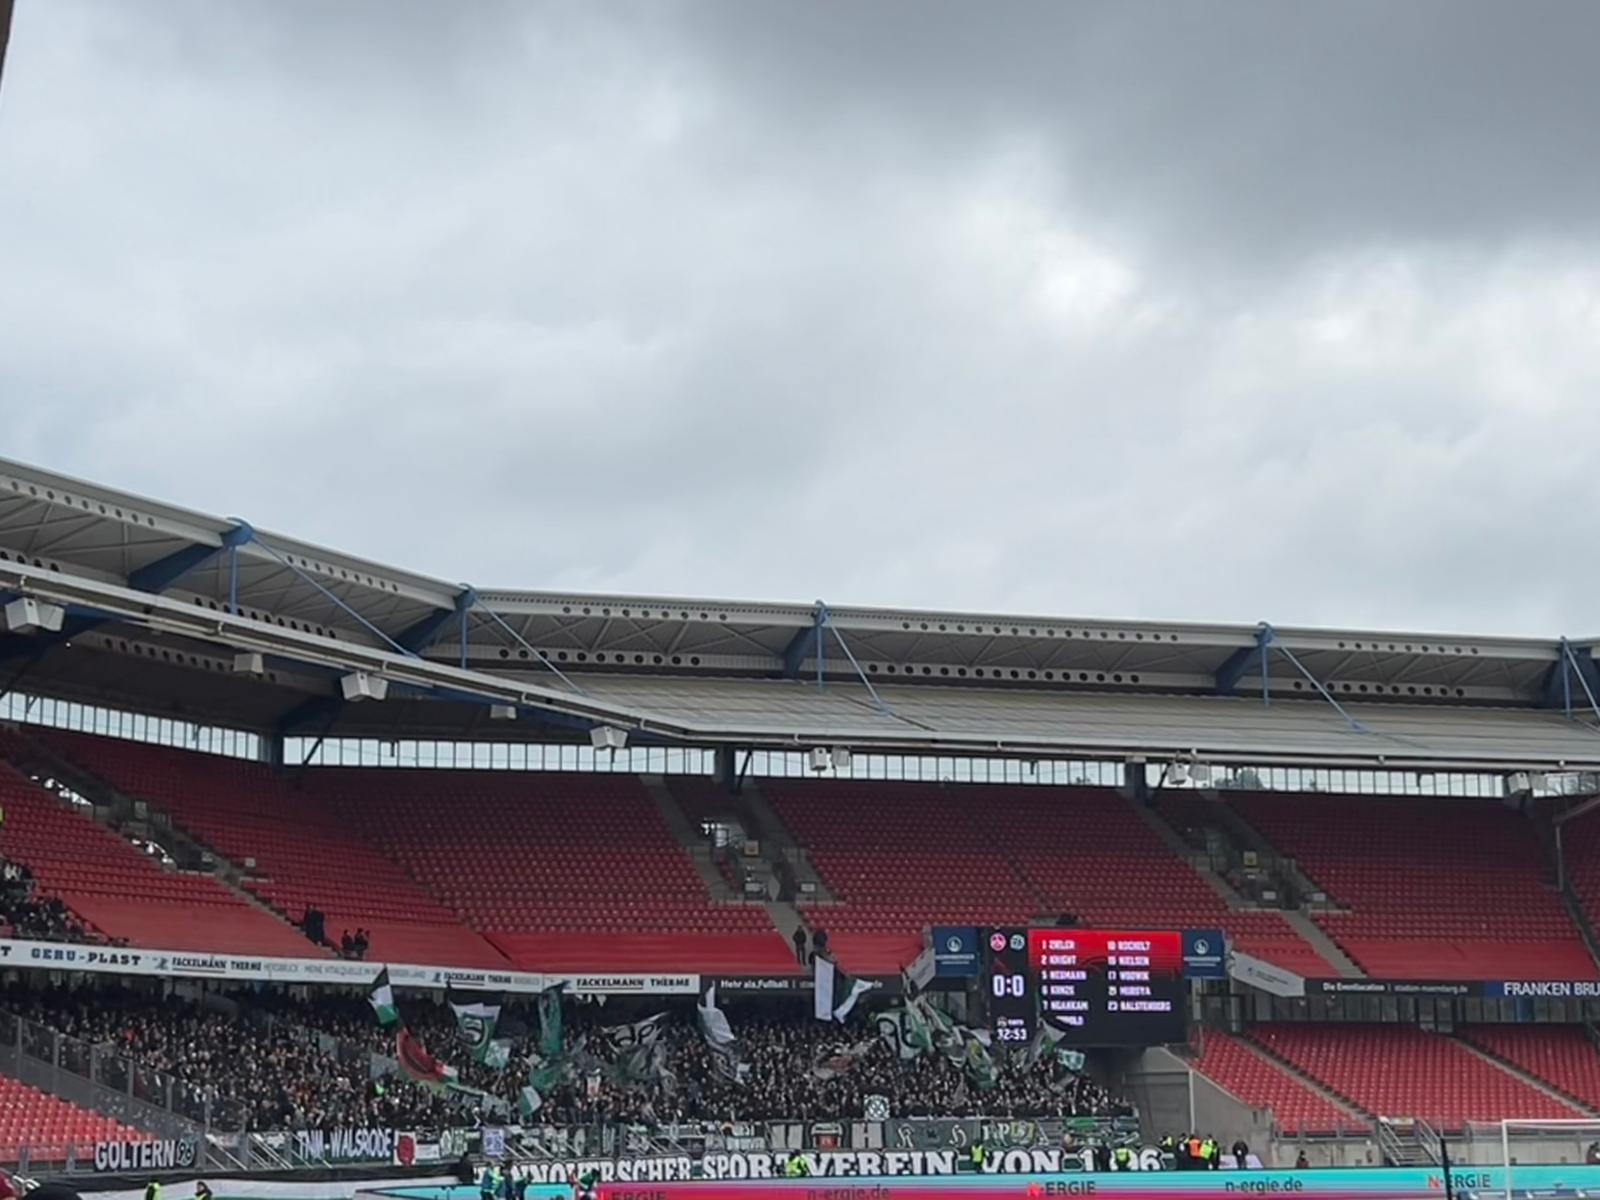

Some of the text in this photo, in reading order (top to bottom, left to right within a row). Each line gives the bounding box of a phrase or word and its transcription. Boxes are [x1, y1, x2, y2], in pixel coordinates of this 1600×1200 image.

[577, 978, 690, 987] FACKELMANN THERME
[993, 975, 1025, 996] 0:0
[1504, 982, 1571, 996] FRANKEN
[95, 1140, 176, 1170] GOLTERN
[1027, 1181, 1096, 1197] N-ERGIE
[1225, 1176, 1303, 1196] n-ergie.de
